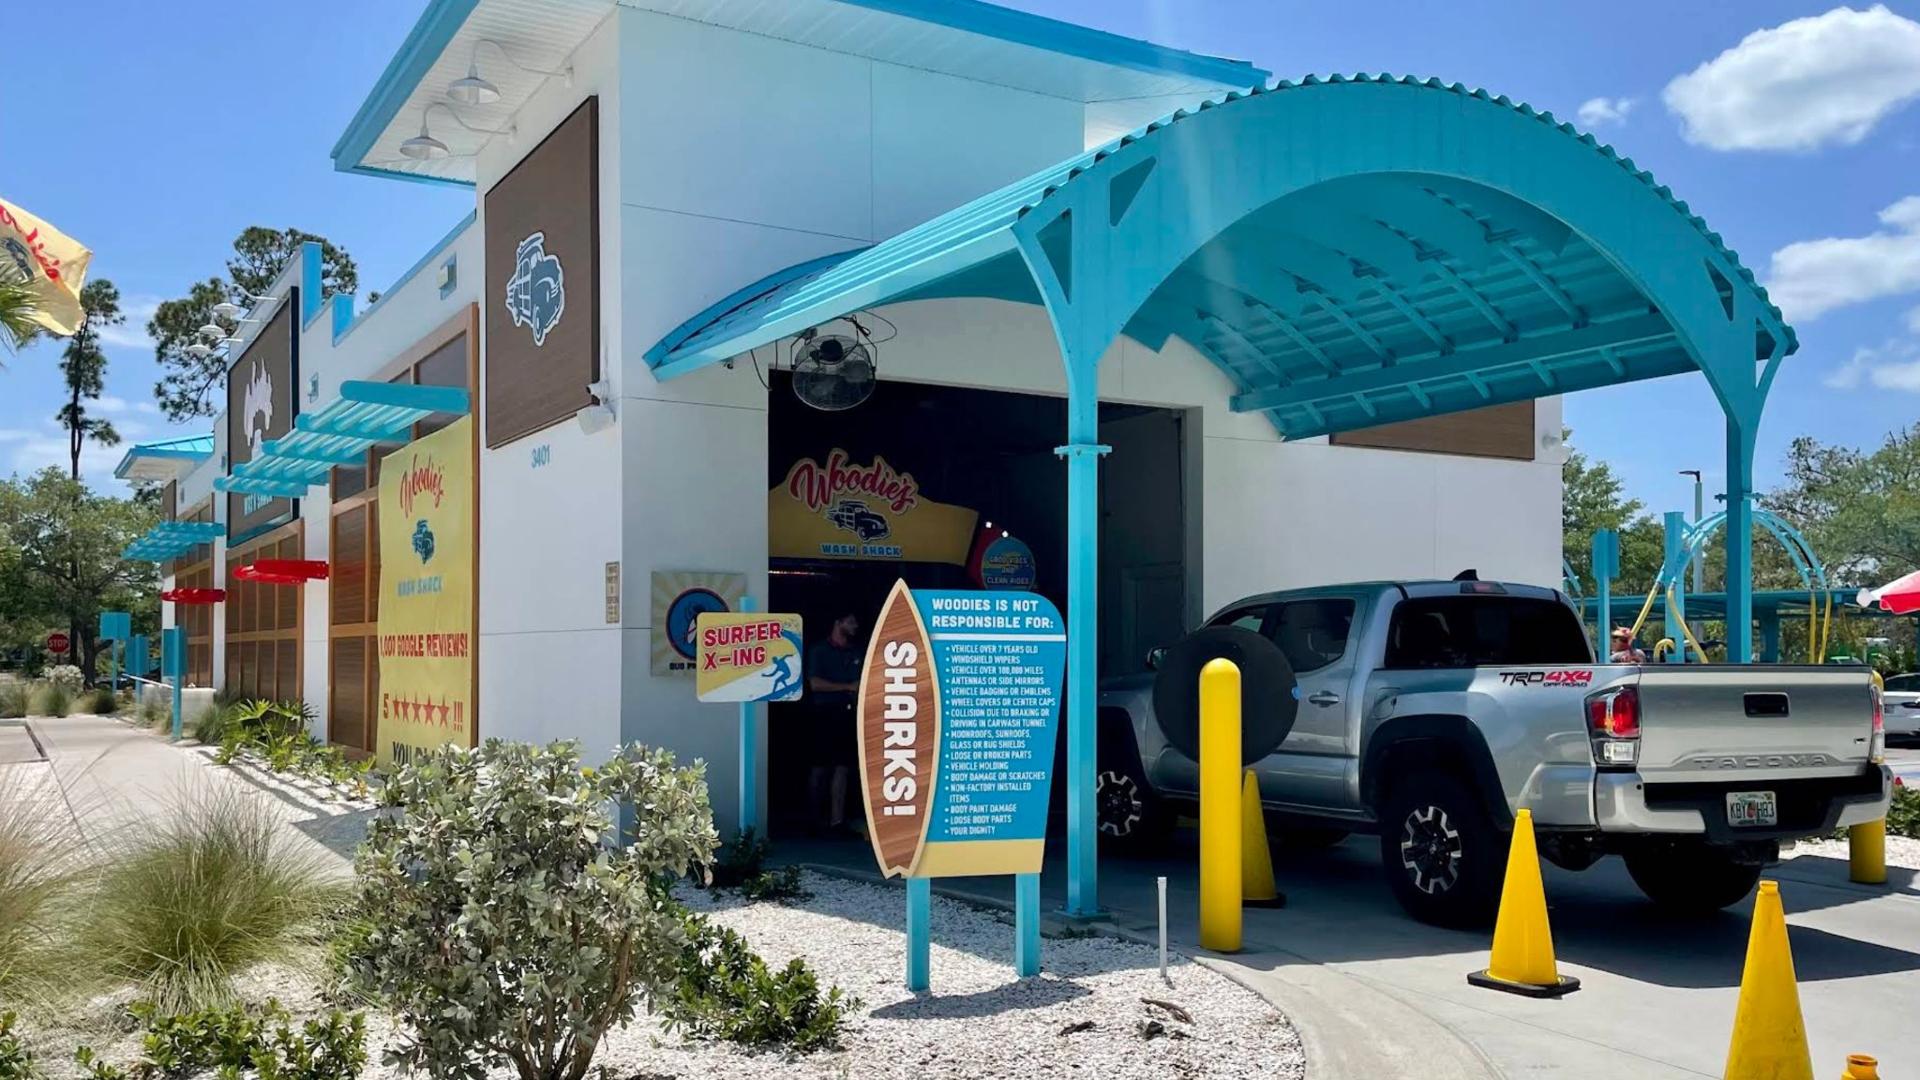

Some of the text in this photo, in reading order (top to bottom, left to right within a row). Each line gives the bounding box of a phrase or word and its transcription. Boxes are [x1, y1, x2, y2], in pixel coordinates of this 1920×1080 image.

[531, 445, 550, 468] 3401
[400, 452, 445, 519] Woodie's
[790, 452, 917, 511] Woodie's
[821, 543, 902, 557] WASH SHACK
[932, 598, 1039, 611] WOODIES IS NOT
[932, 616, 1054, 628] RESPONSIBLE FOR:
[704, 623, 782, 646] SURFER
[48, 640, 68, 648] STOP
[398, 634, 423, 657] GOOGLE
[427, 633, 468, 657] REVIEWS!
[951, 645, 1038, 653] VEHICLE OVER 7 YEARS OLD
[704, 647, 765, 670] X-ING
[951, 656, 1020, 664] WINDSHIELD WIPERS
[951, 666, 979, 674] VEHICLE
[980, 666, 996, 674] OVER
[1024, 666, 1044, 674] MILES
[951, 677, 1044, 685] ANTENNAS OR SIDE MIRRORS
[1500, 672, 1545, 686] TRD
[951, 687, 1051, 695] VEHICLE BADGING OR EMBLEMS
[384, 693, 389, 719] 5
[951, 698, 1056, 706] WHEEL COVERS OR CENTER CAPS
[951, 708, 1050, 717] COLLISION DUE TO BRAKING OR
[883, 640, 918, 816] SHARKS!
[950, 719, 1046, 728] DRIVING IN CARWASH TUNNEL
[950, 740, 971, 749] GLASS
[973, 740, 982, 749] OR
[999, 740, 1025, 748] SHIELDS
[392, 741, 412, 767] YOU
[951, 750, 1032, 760] LOOSE OR BROKEN PARTS
[951, 762, 978, 770] VEHICLE
[1694, 754, 1827, 769] TACOMA
[951, 771, 1046, 781] BODY DAMAGE OR SCRATCHES
[950, 782, 1031, 792] NON-FACTORY INSTALLED
[949, 795, 970, 803] ITEMS
[950, 804, 1017, 814] BODY PAINT DAMAGE
[950, 815, 1012, 825] LOOSE BODY PARTS
[949, 826, 995, 835] YOUR DIGNITY
